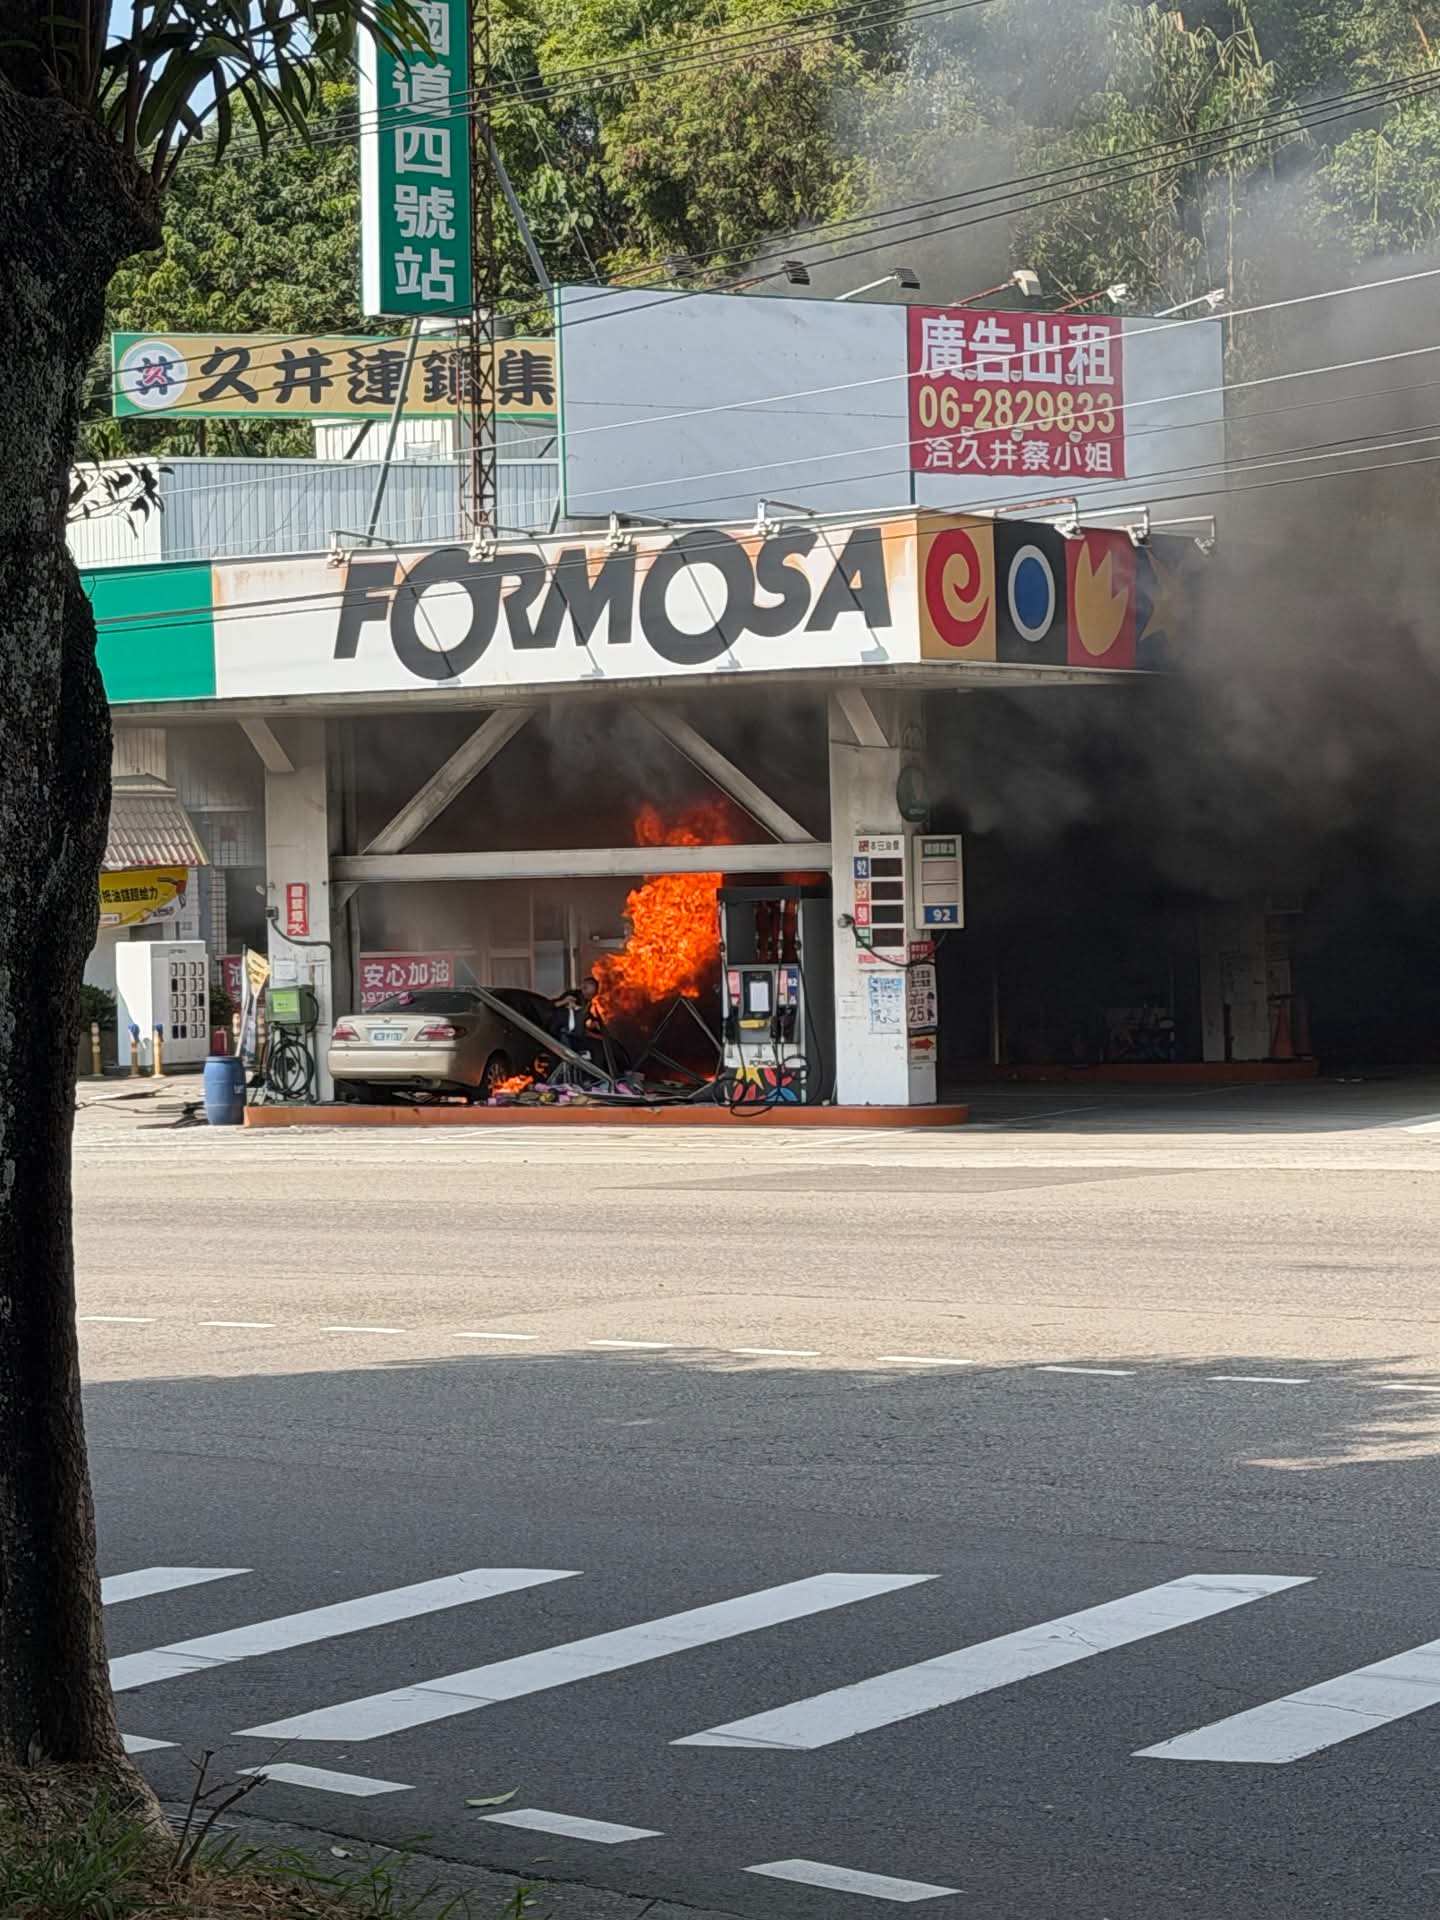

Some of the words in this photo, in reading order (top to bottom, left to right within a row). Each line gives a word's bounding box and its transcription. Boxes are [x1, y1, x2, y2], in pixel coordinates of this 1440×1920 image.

[919, 315, 1115, 386] 廣告出租
[918, 385, 1116, 434] 06-2829833
[924, 437, 1113, 473] 洽久井蔡小姐
[333, 526, 893, 681] FORMOSA
[933, 908, 951, 922] 92
[364, 960, 449, 988] 安心加油
